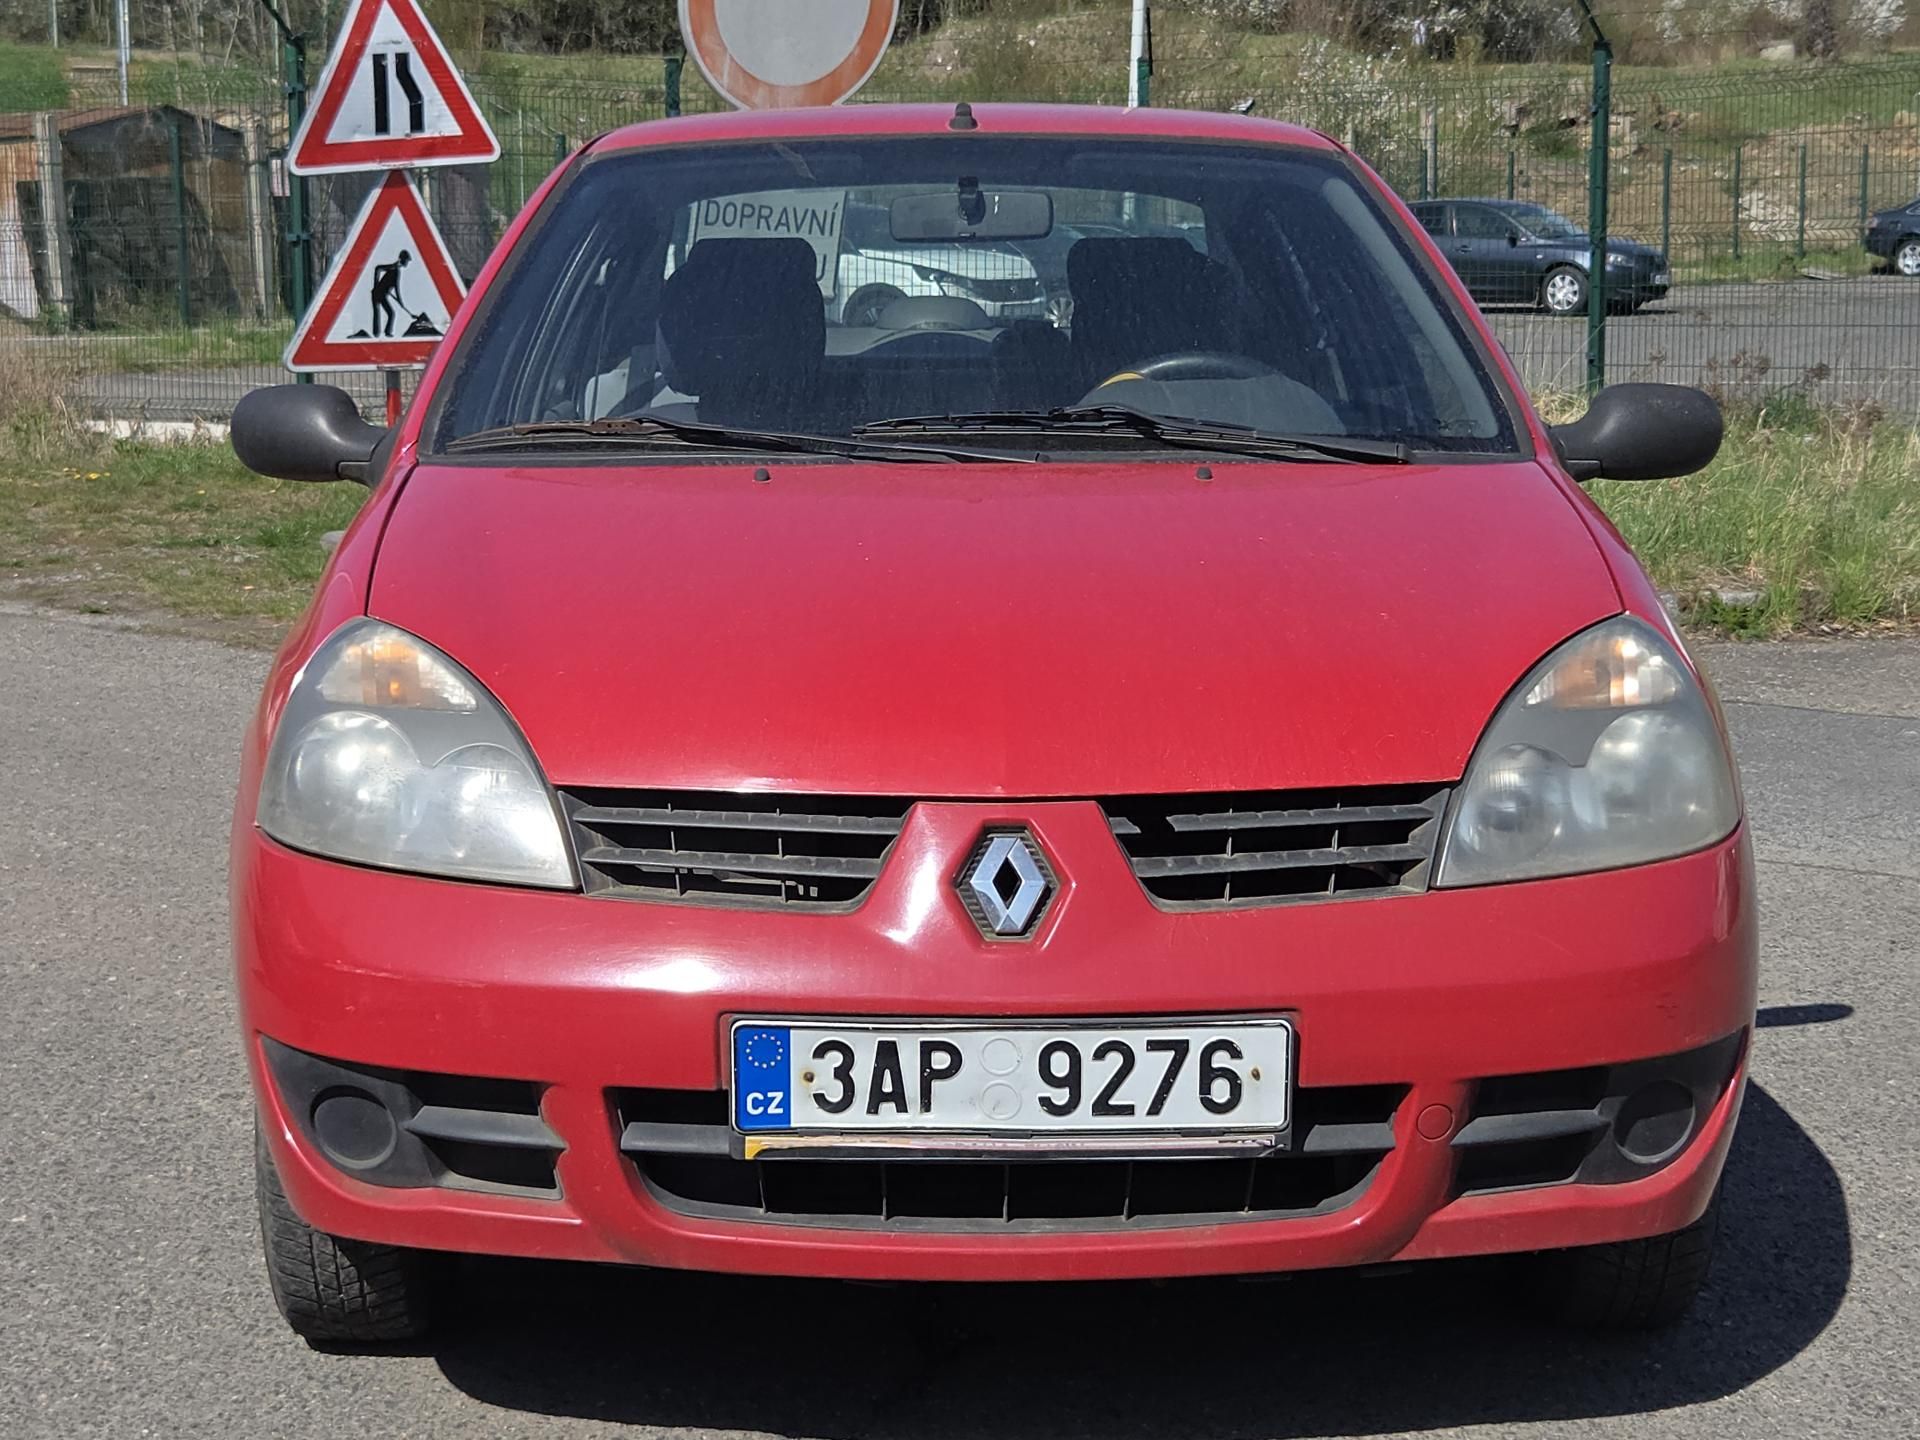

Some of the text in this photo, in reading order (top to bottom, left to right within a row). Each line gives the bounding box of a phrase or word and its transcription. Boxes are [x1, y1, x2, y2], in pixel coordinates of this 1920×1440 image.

[704, 200, 838, 236] DOPRAVNÍ
[812, 1039, 1243, 1117] 3AP 9276
[746, 1092, 784, 1115] CZ
